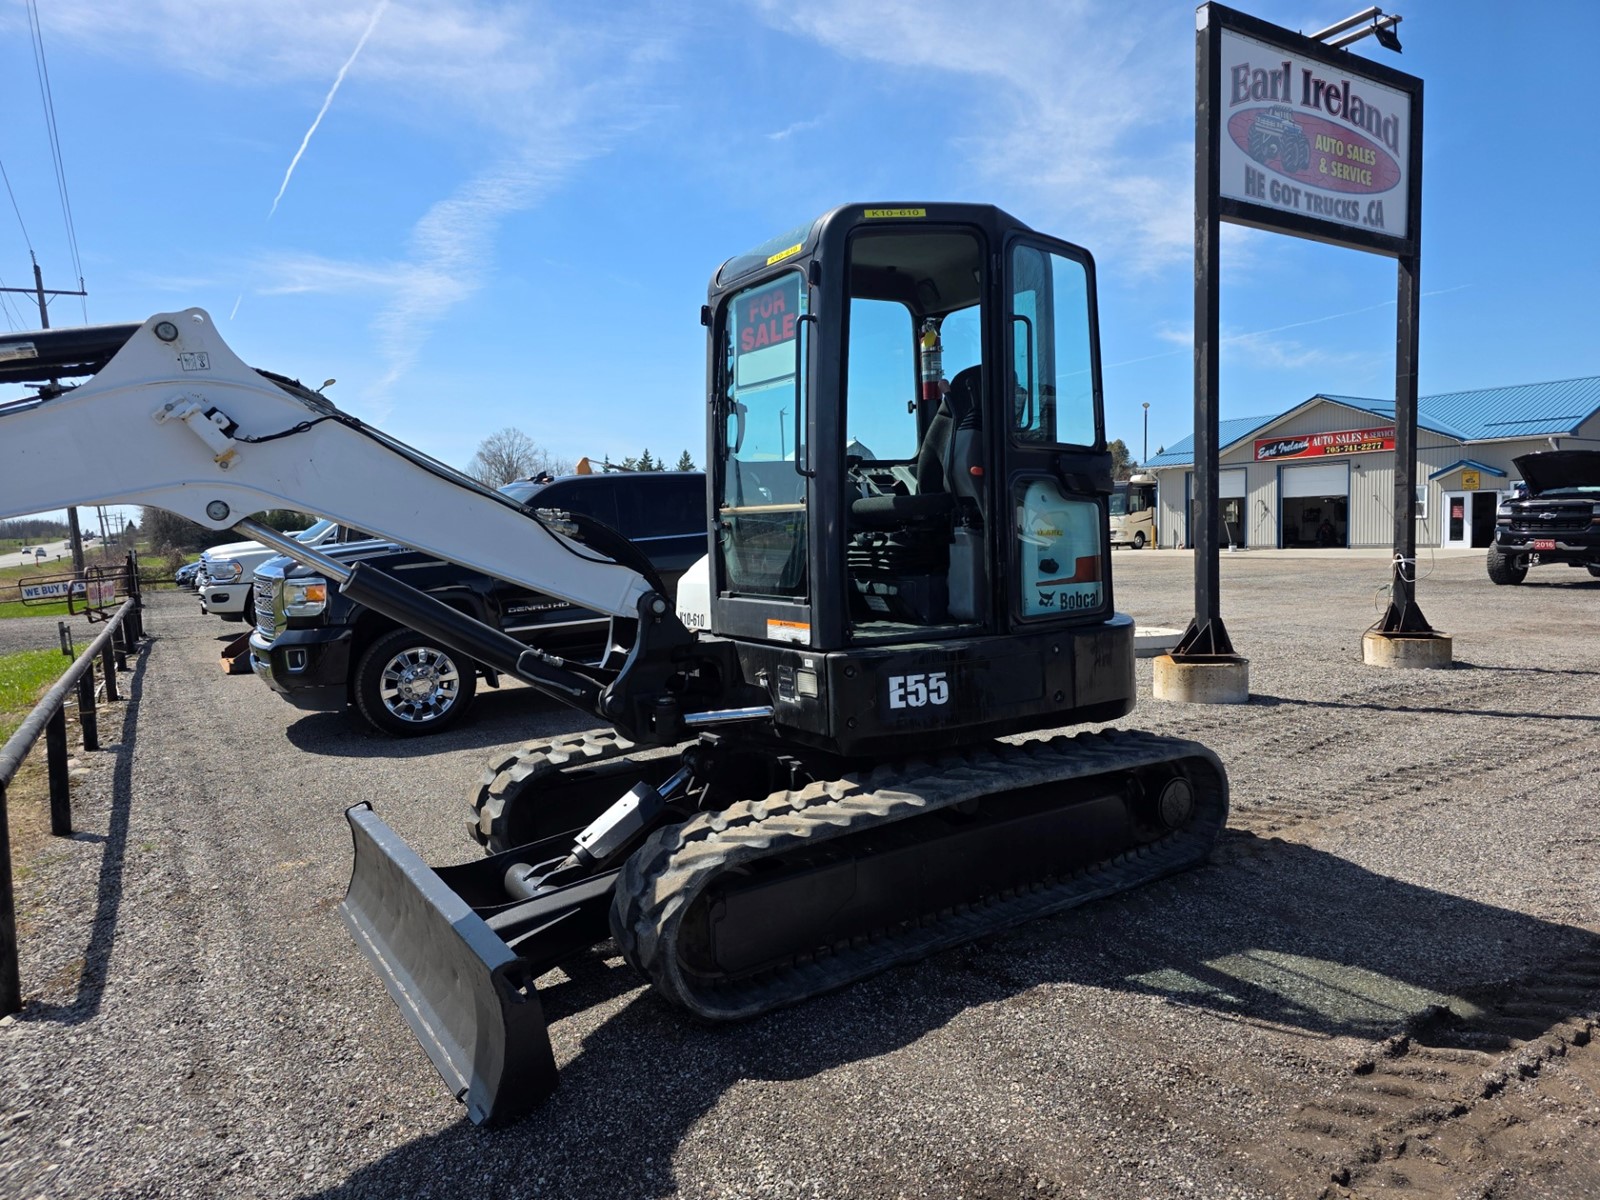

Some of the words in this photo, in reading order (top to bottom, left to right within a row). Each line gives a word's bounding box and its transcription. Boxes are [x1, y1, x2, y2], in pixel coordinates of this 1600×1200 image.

[1230, 61, 1292, 107] Earl
[1302, 68, 1400, 158] Ireland
[1315, 134, 1344, 157] AUTO
[1347, 143, 1376, 166] SALES
[1319, 158, 1328, 174] &
[1331, 163, 1372, 186] SERVICE
[1244, 164, 1265, 200] HE
[1269, 179, 1301, 206] GOT
[1304, 191, 1359, 223] TRUCKS
[871, 209, 919, 217] K10-610
[749, 289, 785, 322] FOR
[741, 313, 795, 351] SALE
[1312, 435, 1333, 447] AUTO
[1336, 432, 1362, 444] SALES
[1257, 445, 1277, 459] Earl
[1325, 442, 1382, 454] 705-741-2277
[1535, 541, 1554, 549] 2016
[24, 587, 40, 597] WE
[42, 584, 60, 595] BUY
[507, 603, 552, 613] DENALI
[680, 612, 705, 627] K10-610
[888, 671, 949, 709] E55
